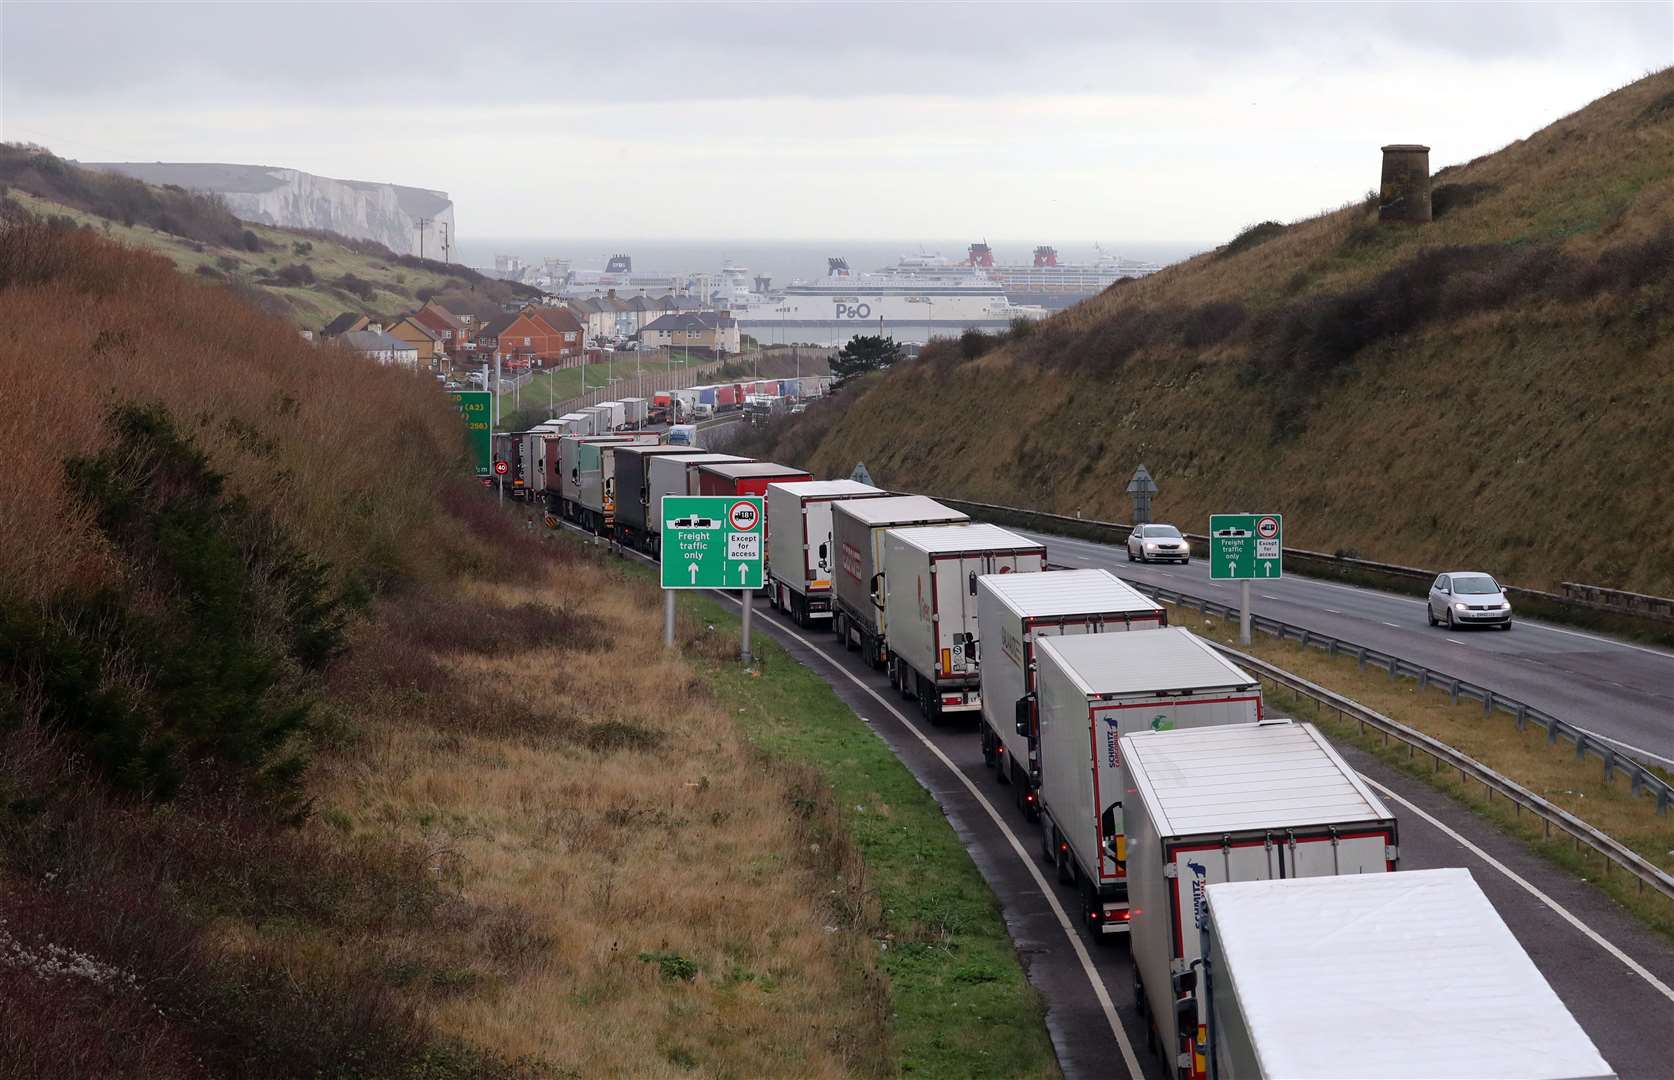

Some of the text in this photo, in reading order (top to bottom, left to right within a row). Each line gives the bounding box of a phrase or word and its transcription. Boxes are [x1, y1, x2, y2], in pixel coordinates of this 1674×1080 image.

[836, 303, 871, 319] P&O
[678, 531, 710, 541] Freight
[731, 535, 757, 543] Except
[680, 541, 708, 550] traffic
[684, 551, 703, 560] only
[1107, 731, 1116, 768] SCHMITZ
